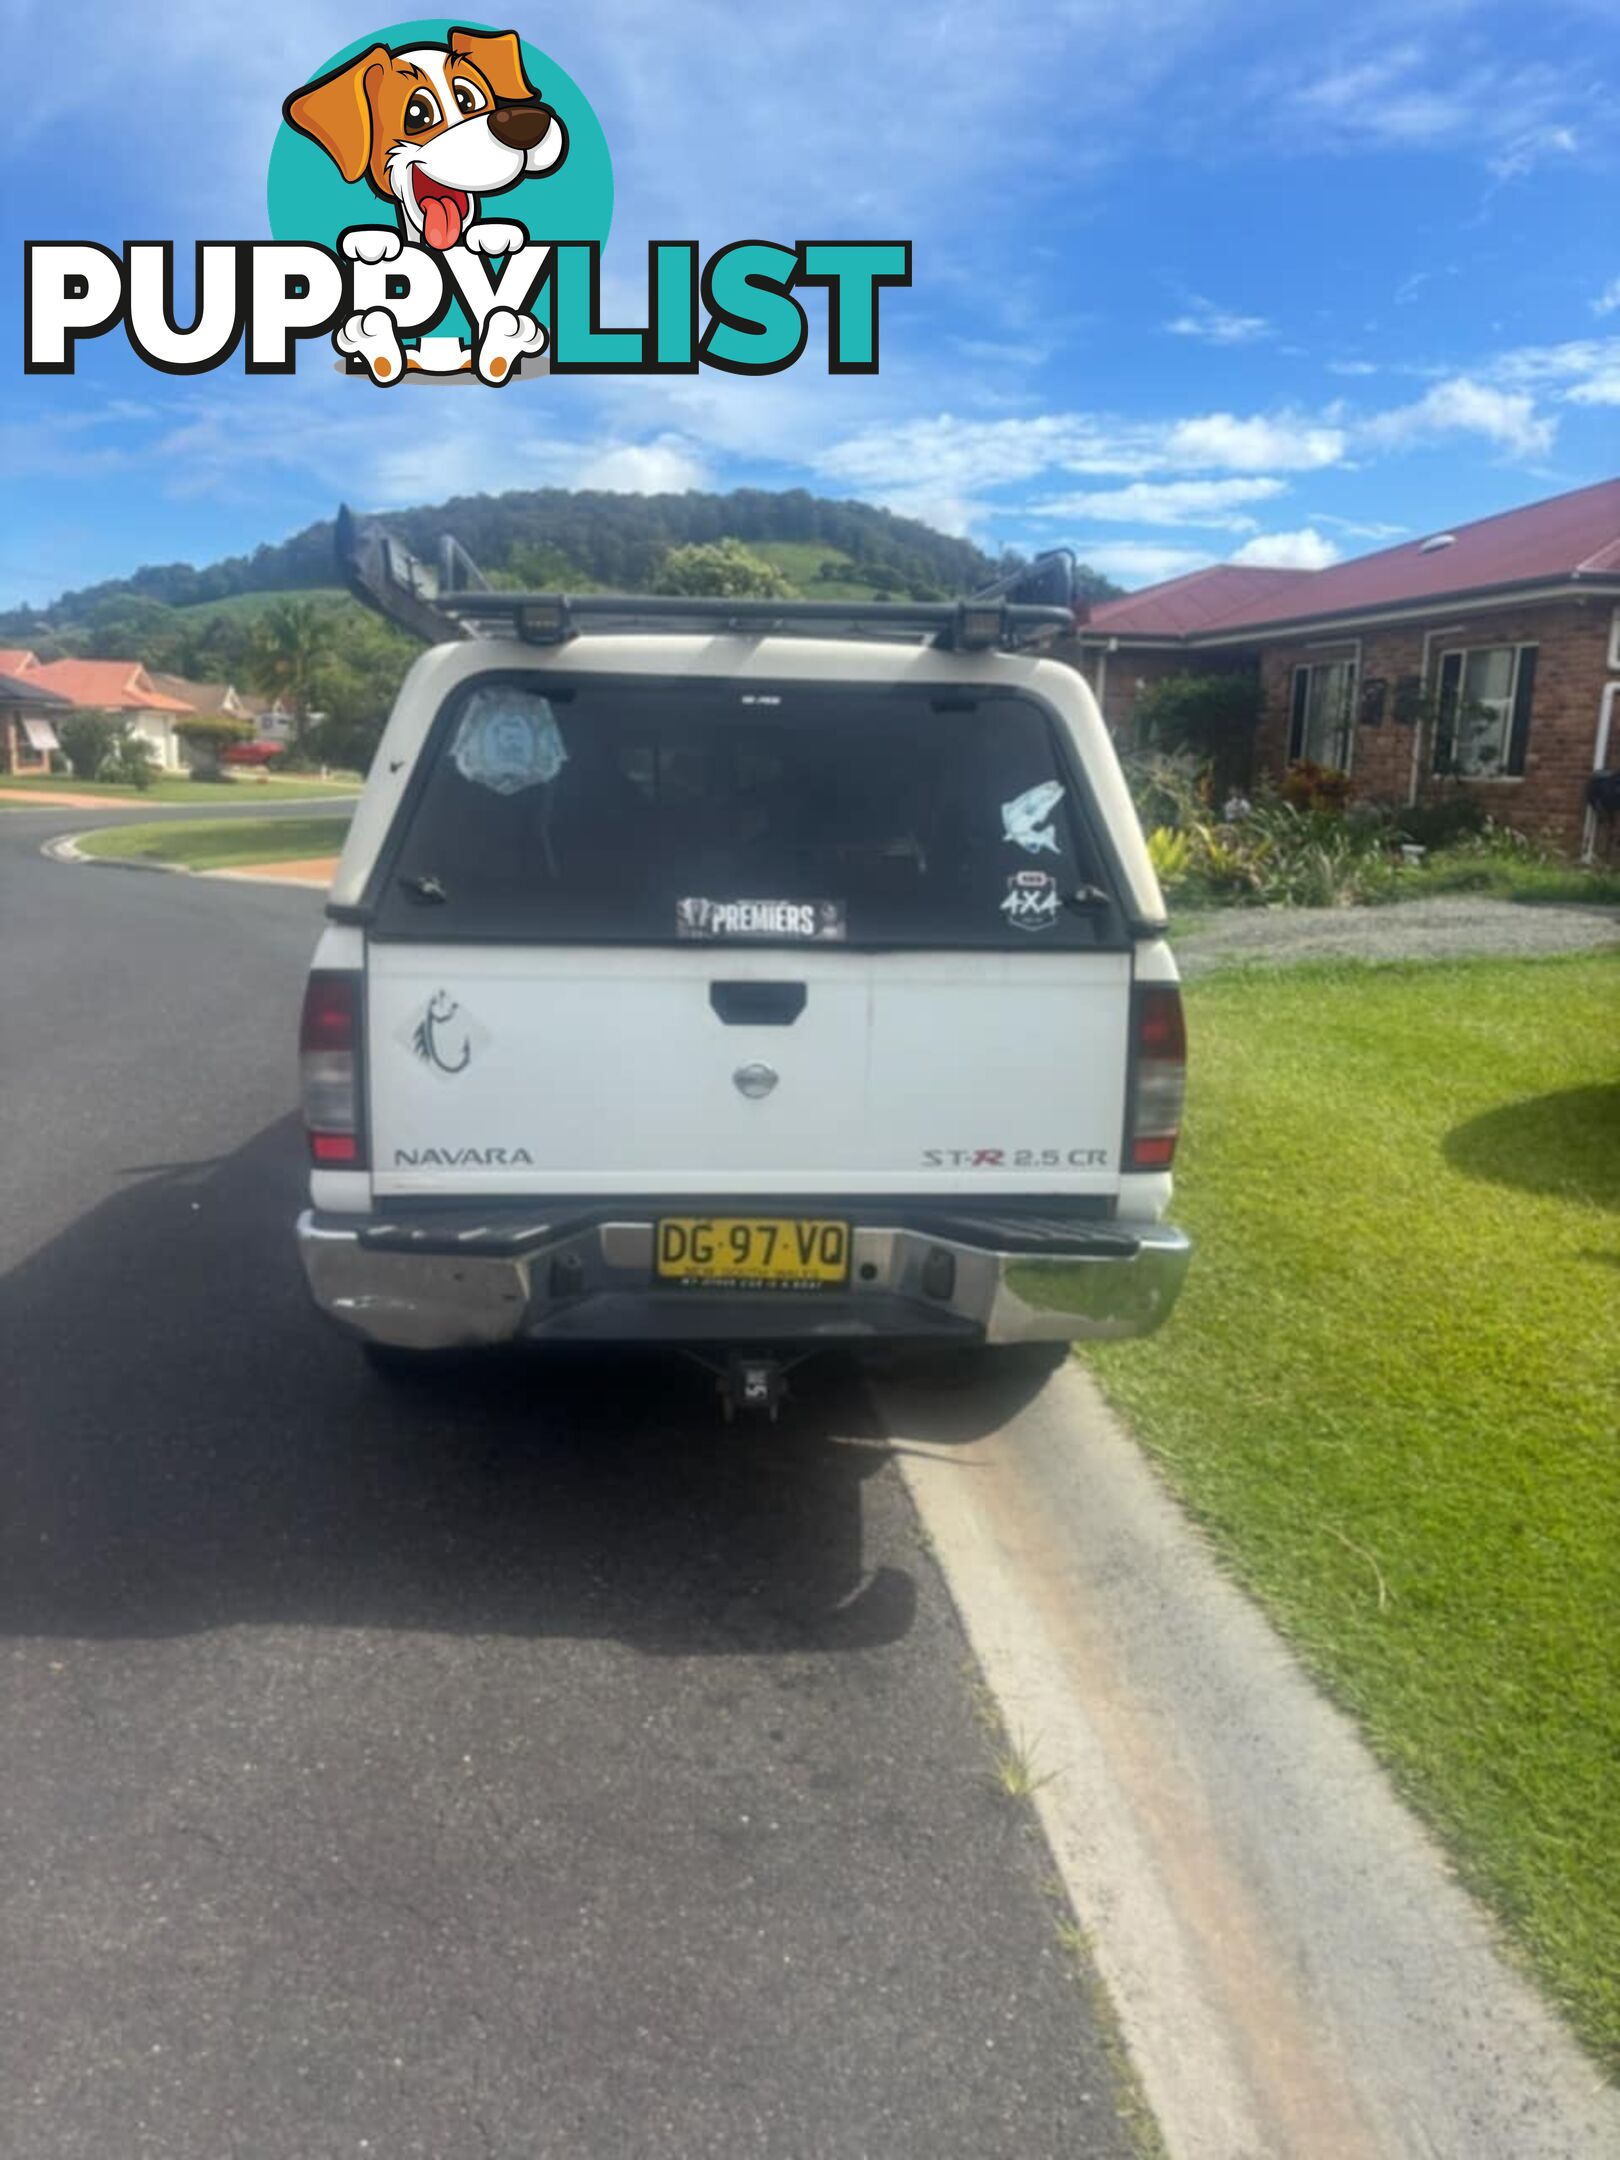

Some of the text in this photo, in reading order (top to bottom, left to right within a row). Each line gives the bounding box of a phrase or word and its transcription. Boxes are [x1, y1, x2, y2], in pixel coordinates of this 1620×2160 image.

[712, 903, 814, 935] PREMIERS
[394, 1147, 534, 1167] NAVARA
[1013, 1149, 1060, 1167] 2.5
[1067, 1149, 1107, 1167] CR
